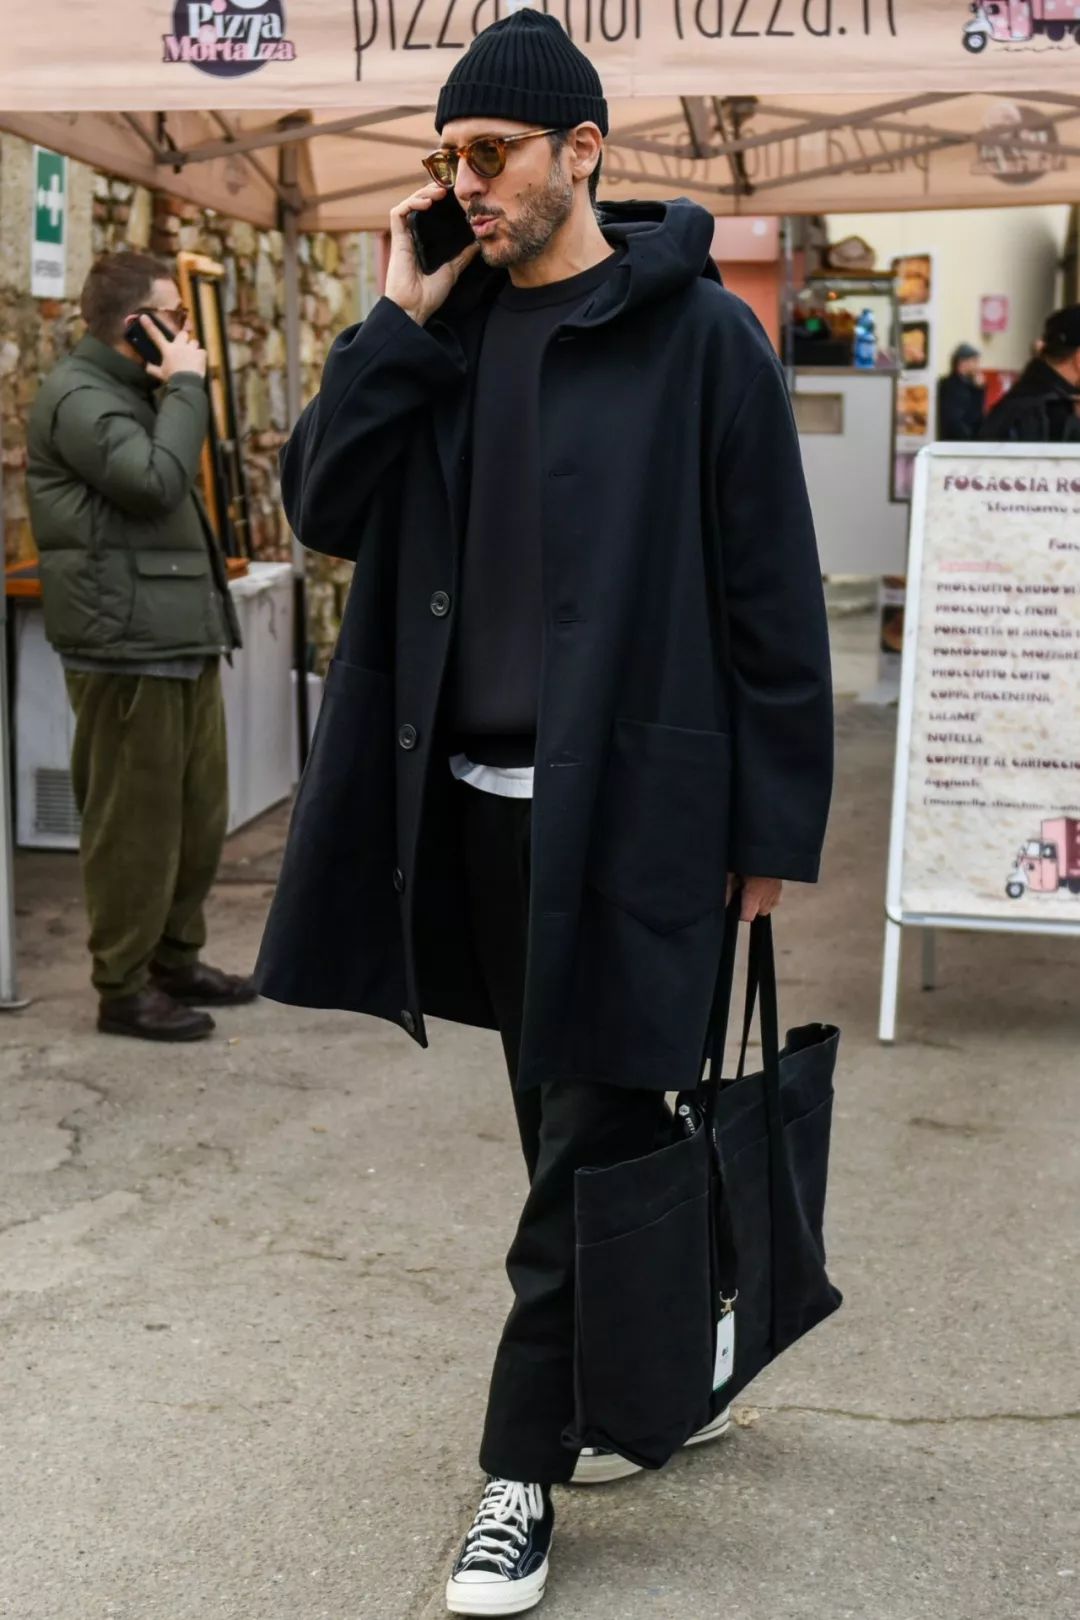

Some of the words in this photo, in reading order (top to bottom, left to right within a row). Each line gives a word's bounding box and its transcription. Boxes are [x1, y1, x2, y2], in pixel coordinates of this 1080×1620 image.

[187, 2, 282, 38] Pizza
[943, 476, 1048, 491] FOCACCIA
[927, 732, 983, 744] NUTELLA
